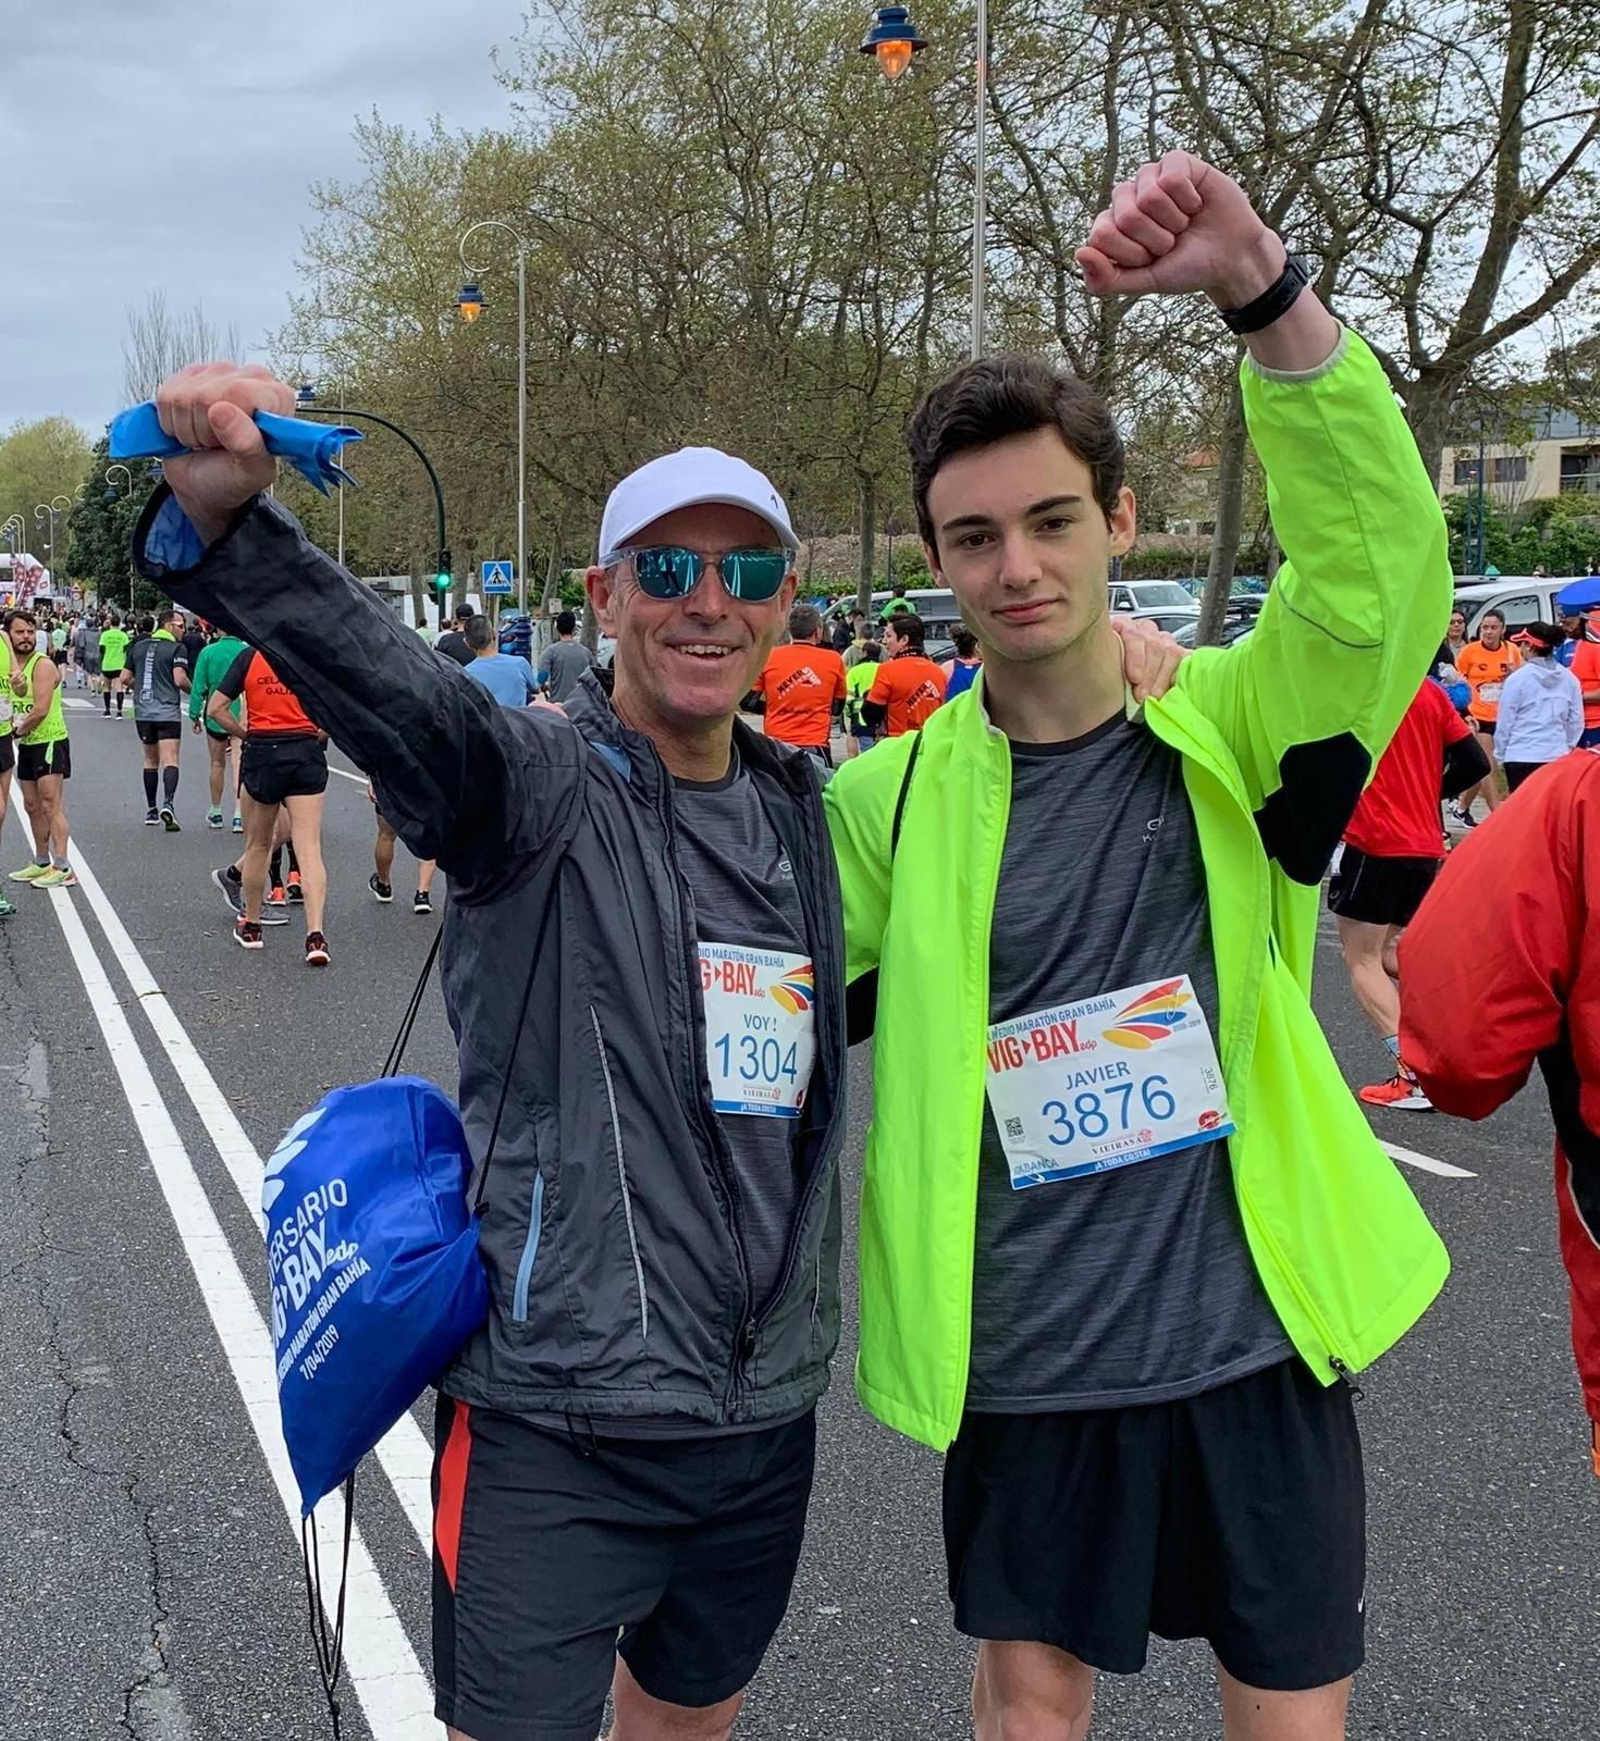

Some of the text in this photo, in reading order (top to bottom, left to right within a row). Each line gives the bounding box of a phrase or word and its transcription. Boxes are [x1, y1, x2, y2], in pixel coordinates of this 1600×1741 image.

[257, 676, 280, 685] CEL
[712, 949, 744, 962] MARATÓN
[745, 953, 764, 966] GRAN
[765, 955, 785, 968] BAHÍA
[723, 961, 756, 996] BAY
[1016, 1012, 1059, 1035] MARATÓN
[1058, 1006, 1085, 1022] GRAN
[1087, 997, 1117, 1015] BAHÍA
[714, 1032, 798, 1085] 1304
[1030, 1019, 1080, 1062] BAY
[1066, 1061, 1131, 1090] JAVIER
[1204, 1067, 1218, 1091] 3876
[1042, 1074, 1176, 1146] 3876
[282, 1216, 326, 1311] BAY
[316, 1282, 341, 1319] GRAN
[334, 1256, 371, 1295] BAHÍA
[299, 1323, 340, 1381] 7/04/2019
